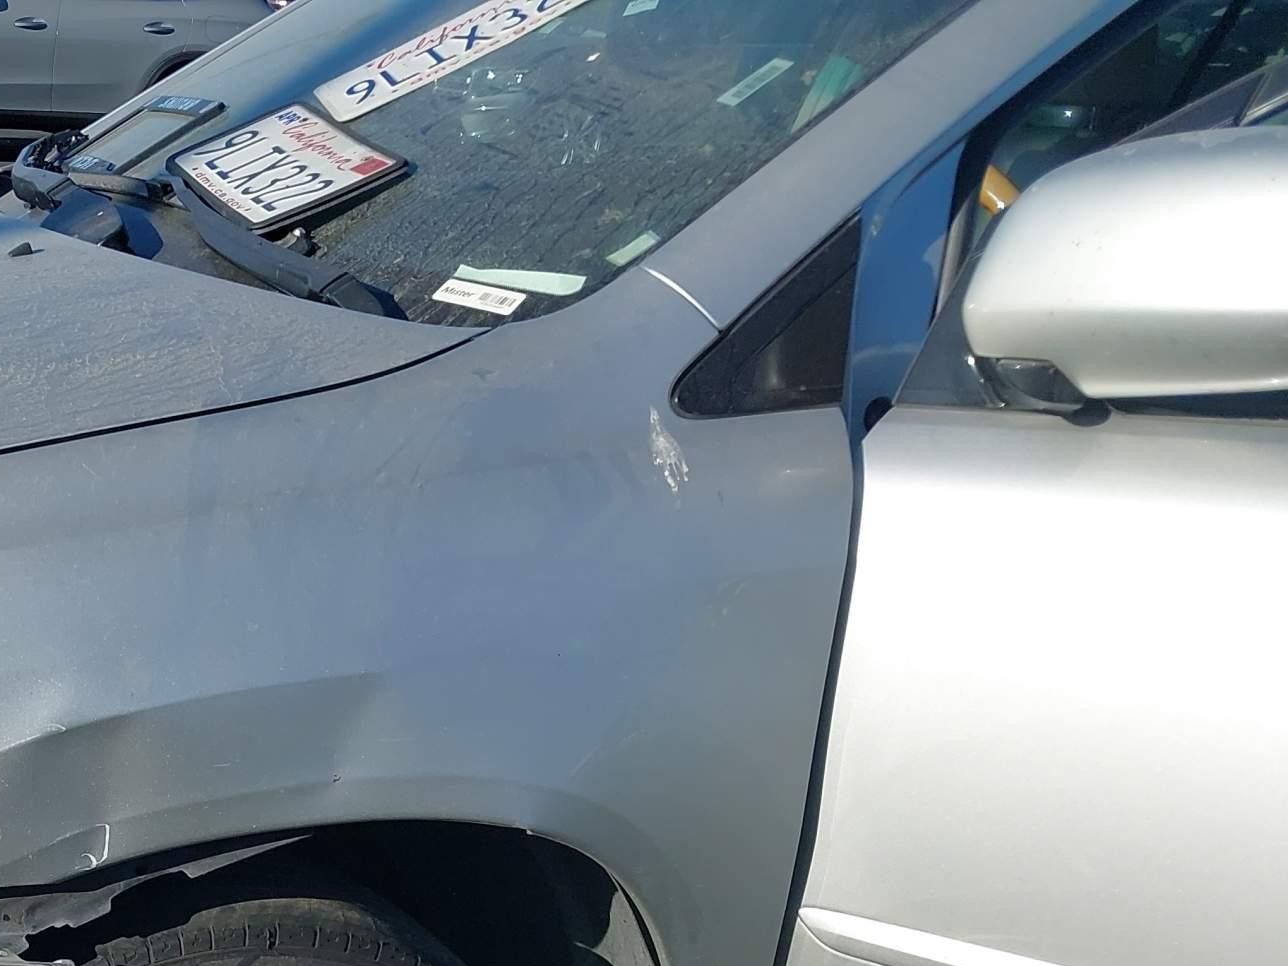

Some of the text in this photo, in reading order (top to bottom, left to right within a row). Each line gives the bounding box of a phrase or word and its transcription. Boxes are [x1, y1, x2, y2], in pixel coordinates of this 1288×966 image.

[376, 0, 511, 70] Californ
[193, 130, 334, 212] 9LIX322
[282, 121, 351, 172] California
[195, 170, 245, 212] dmv.ca.gov
